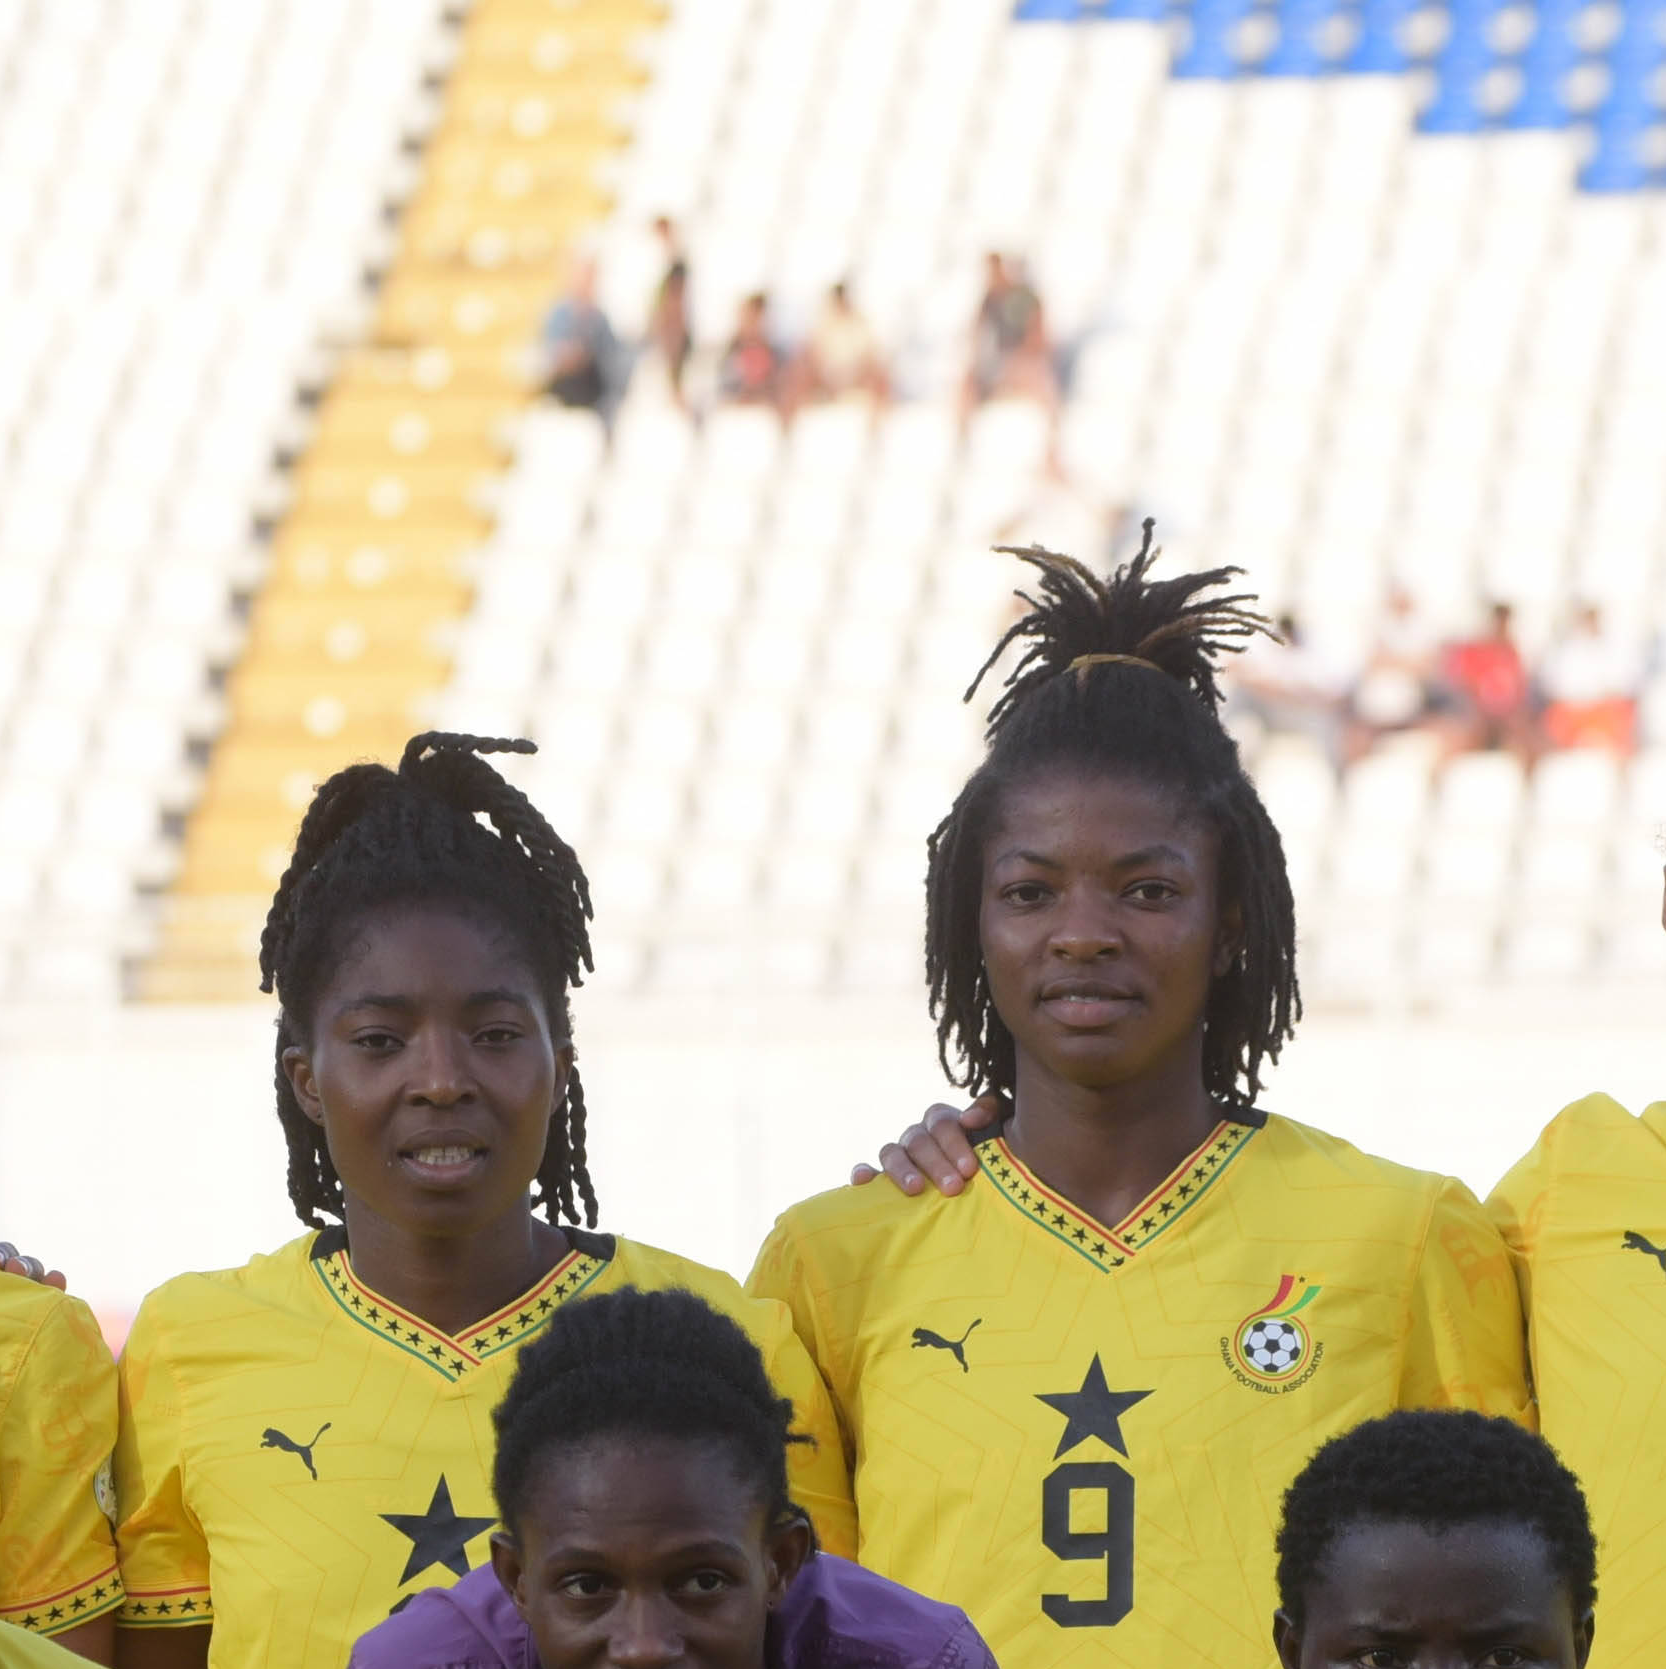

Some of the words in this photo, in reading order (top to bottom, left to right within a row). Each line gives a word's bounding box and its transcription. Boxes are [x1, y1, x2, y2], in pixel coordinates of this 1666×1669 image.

[1220, 1336, 1236, 1371] GHANA
[1233, 1368, 1279, 1394] FOOTBALL
[1282, 1341, 1324, 1393] ASSOCIATION
[1041, 1462, 1135, 1628] 9
